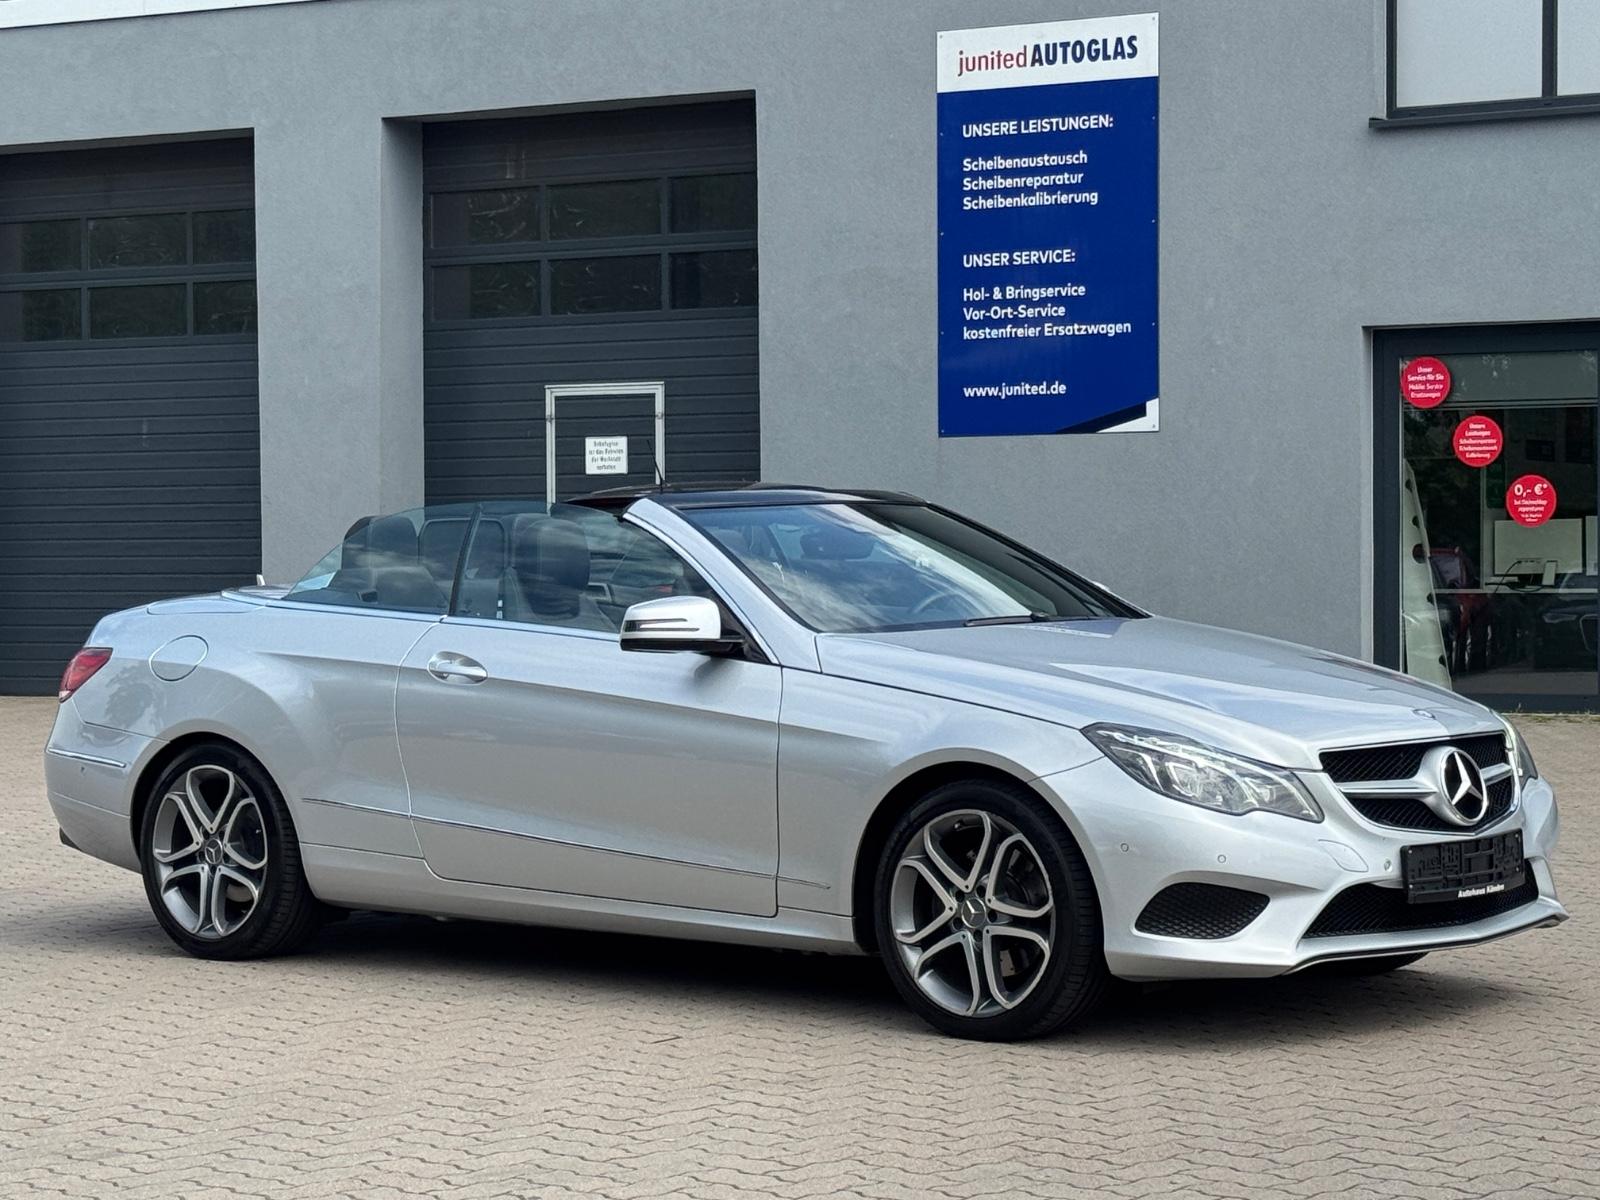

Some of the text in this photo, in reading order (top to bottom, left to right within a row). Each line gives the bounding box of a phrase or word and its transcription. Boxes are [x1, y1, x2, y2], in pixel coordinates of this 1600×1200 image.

[962, 113, 1114, 138] UNSERE LEISTUNGEN:
[962, 150, 1088, 171] Scheibenaustausch
[962, 172, 1084, 191] Scheibenreparatur
[962, 191, 1098, 210] Scheibenkalibrierung
[963, 249, 1076, 268] UNSER SERVICE:
[963, 283, 1086, 301] Hol- & Bringservice
[963, 303, 1066, 320] Vor-Ort-Service
[963, 322, 1131, 340] kostenfreier Ersatzwagen
[963, 381, 1067, 399] www.junited.de
[1458, 888, 1485, 898] Autohaus
